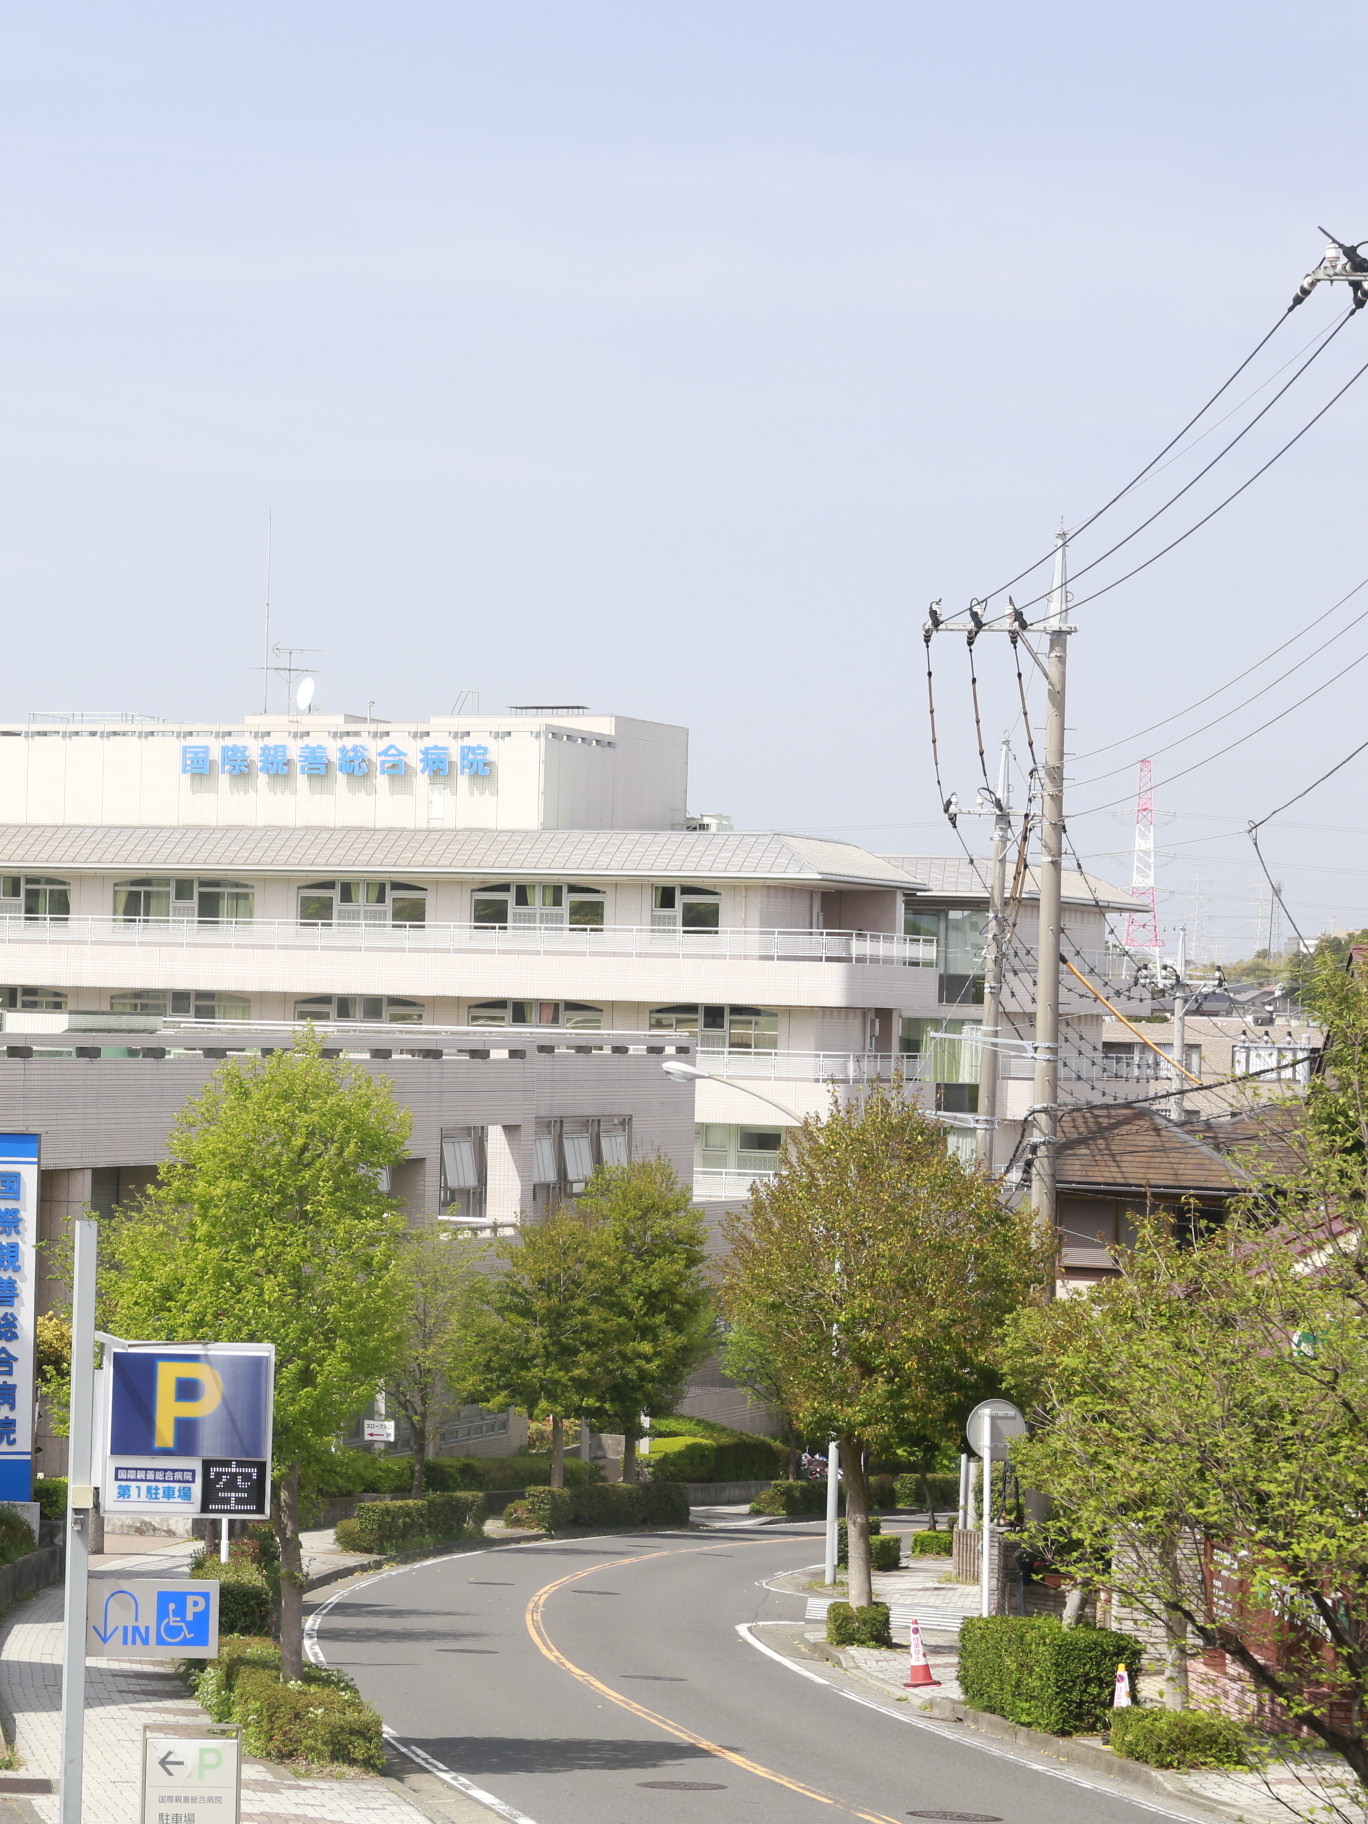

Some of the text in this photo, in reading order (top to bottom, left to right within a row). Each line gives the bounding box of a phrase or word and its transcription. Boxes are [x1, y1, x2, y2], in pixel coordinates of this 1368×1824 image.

[181, 744, 490, 776] 国際親善総合病院
[154, 1360, 224, 1448] P
[117, 1469, 193, 1481] 国際親善総合病院
[209, 1461, 257, 1510] 空
[116, 1484, 192, 1501] 第1駐車場
[186, 1595, 206, 1621] P
[122, 1625, 150, 1646] IN
[198, 1747, 224, 1781] P
[158, 1795, 223, 1804] 国際親善総合病院
[158, 1812, 196, 1824] 駐車場
